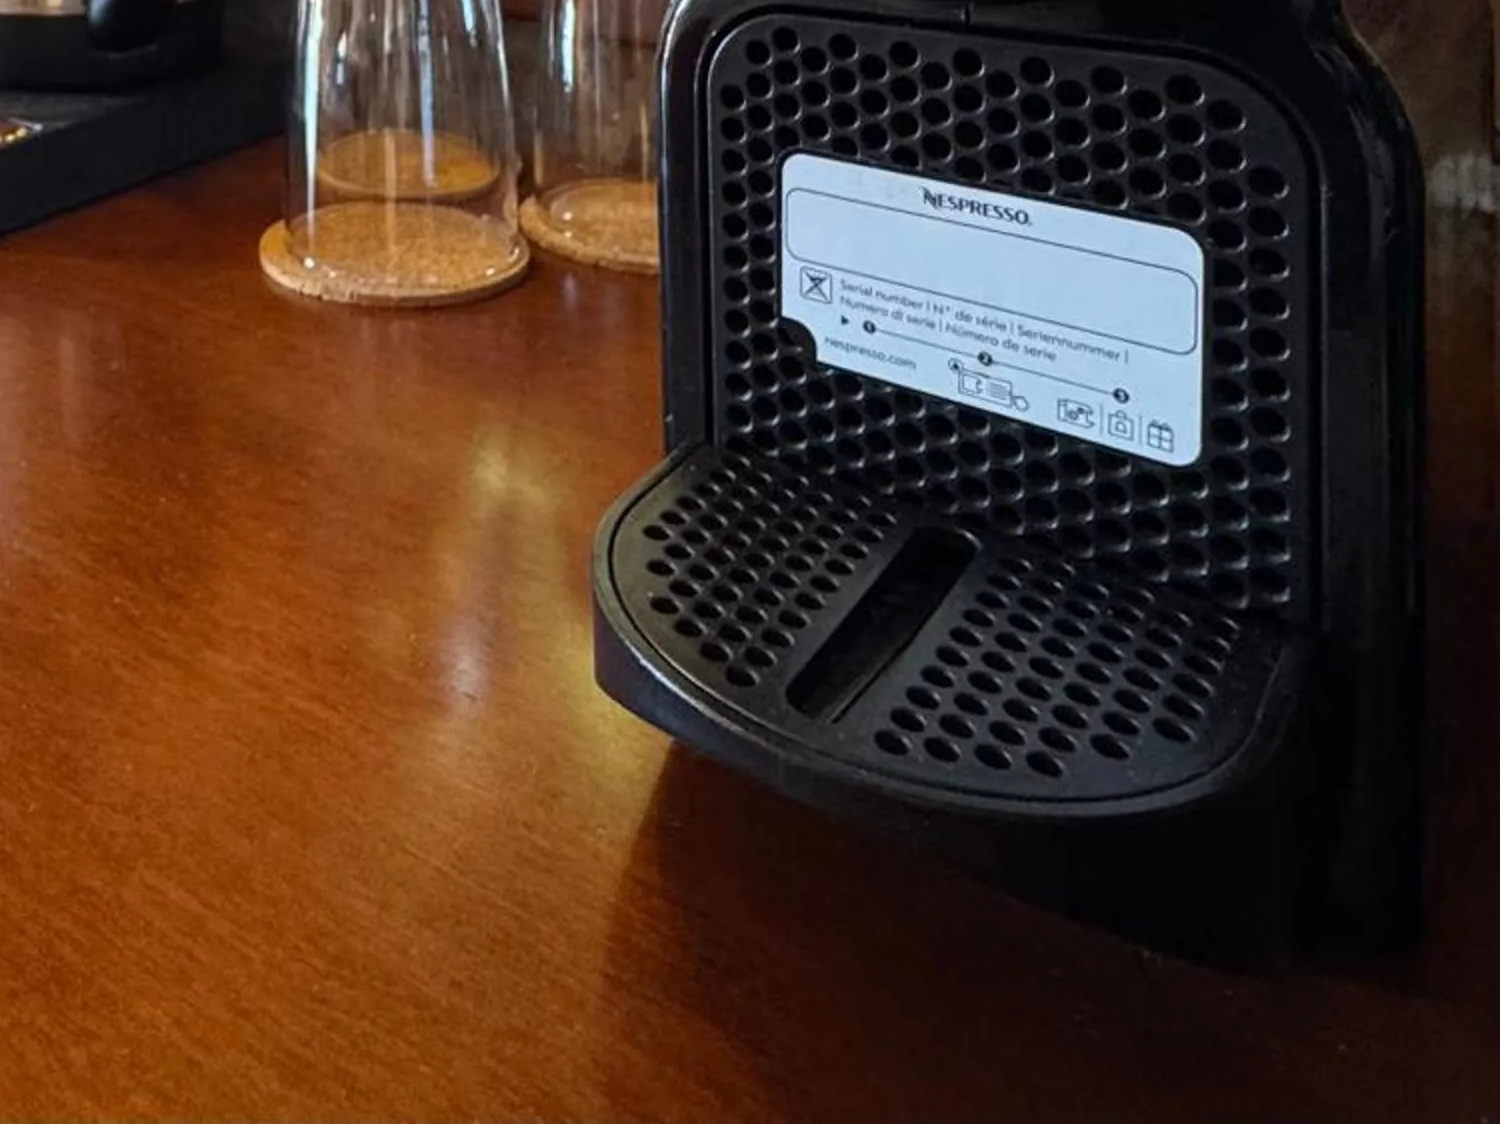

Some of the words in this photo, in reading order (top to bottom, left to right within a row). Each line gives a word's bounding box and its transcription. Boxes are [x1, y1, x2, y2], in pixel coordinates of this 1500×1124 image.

[921, 186, 1030, 225] NESPRESSO
[840, 278, 873, 297] Serial
[876, 290, 923, 310] number
[955, 310, 973, 323] de
[976, 315, 1007, 333] série
[1018, 324, 1121, 361] Seriennummer
[891, 309, 903, 321] di
[906, 314, 936, 330] serie
[1002, 339, 1020, 352] de
[1023, 345, 1057, 362] serie
[824, 336, 917, 370] nespresso.com
